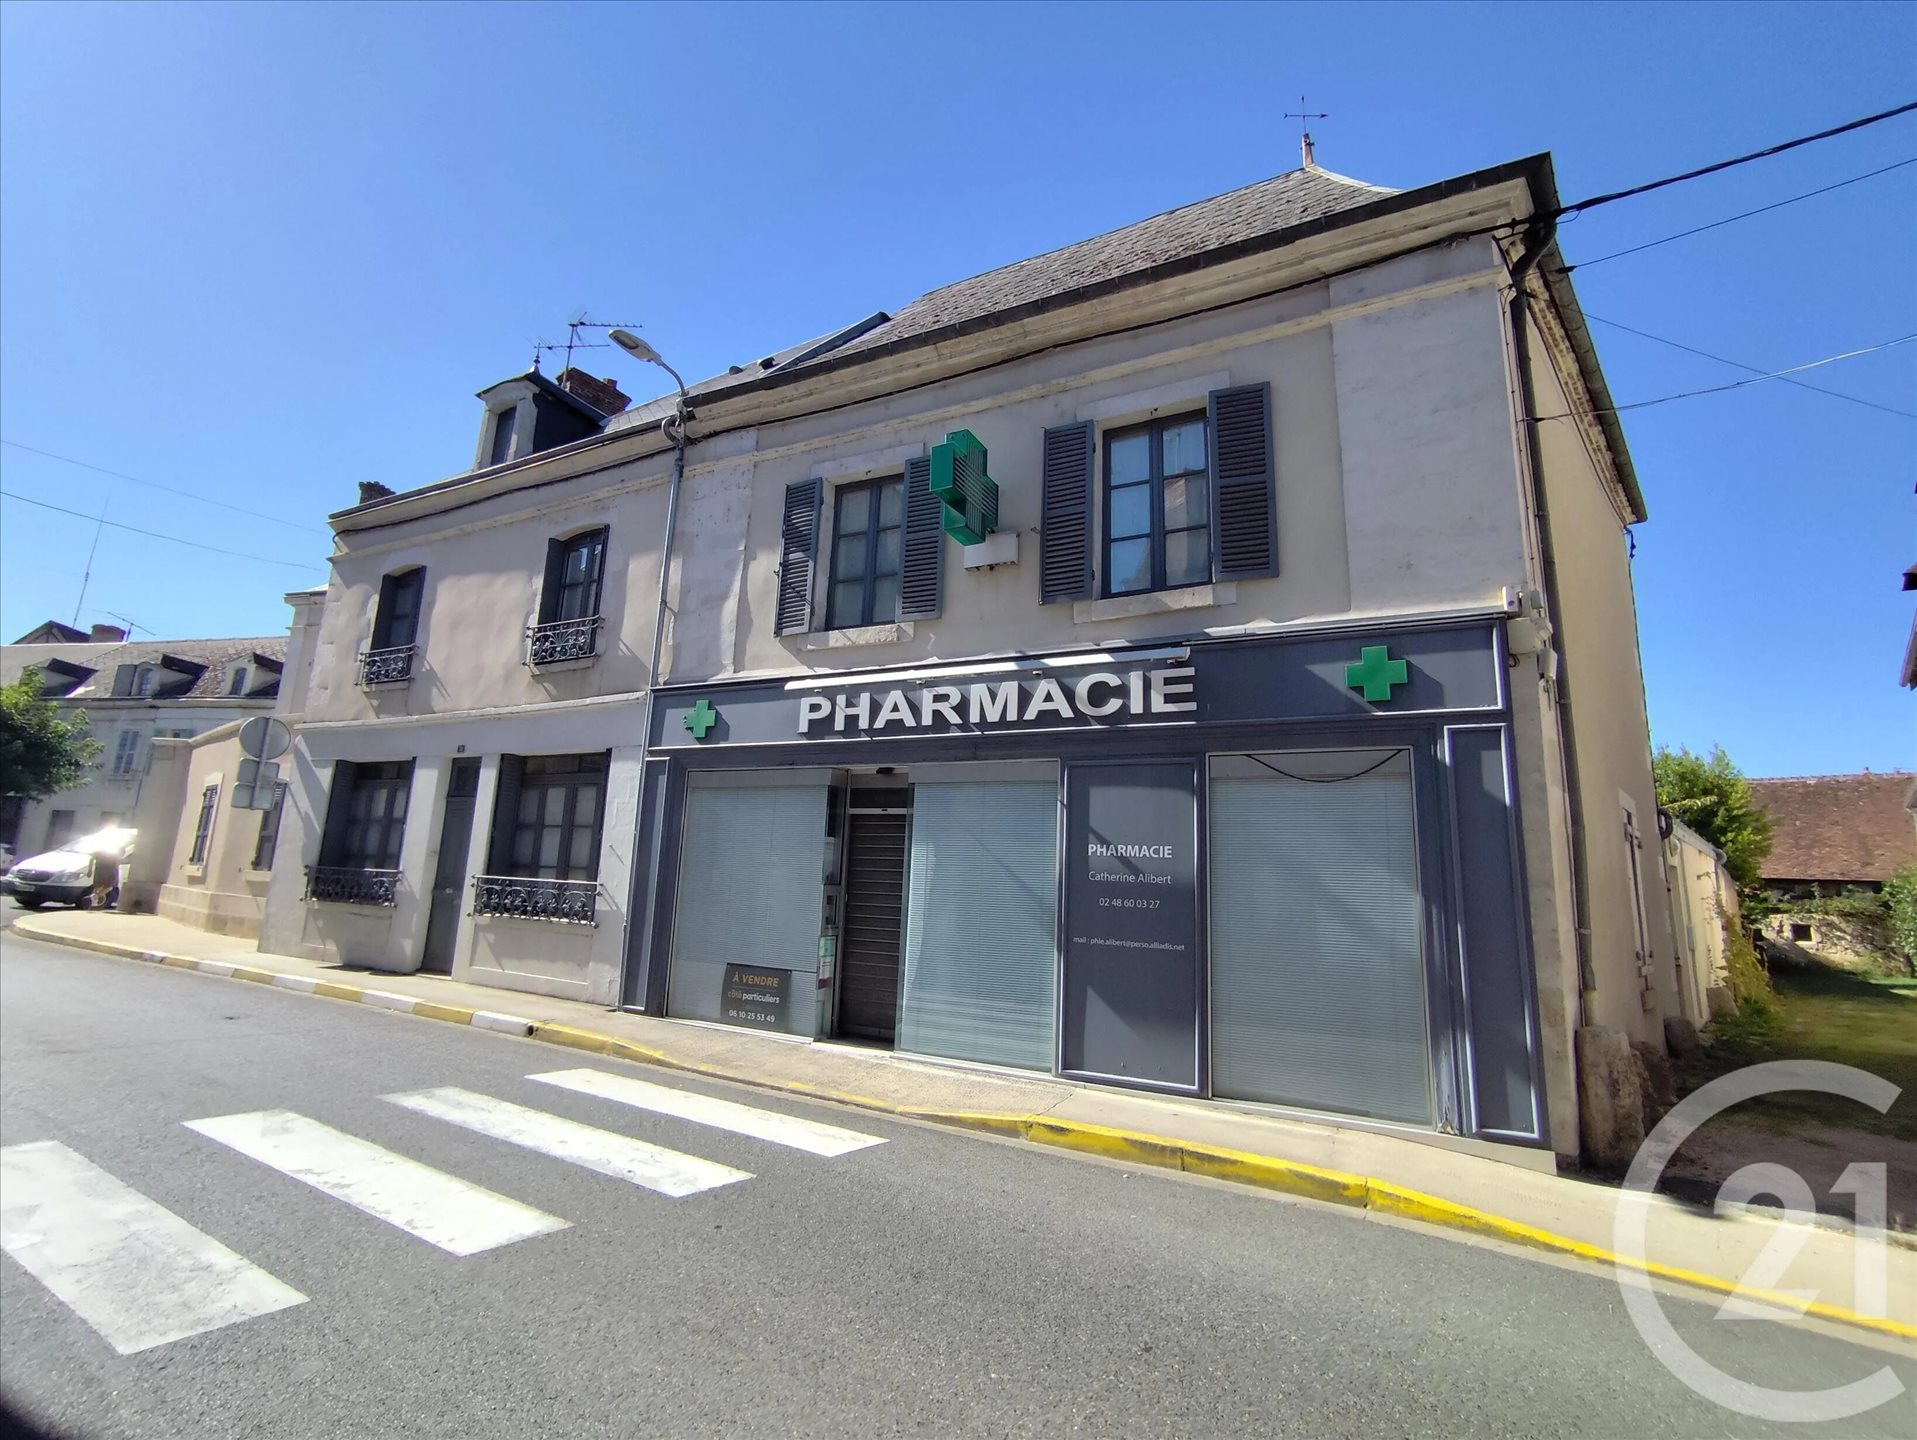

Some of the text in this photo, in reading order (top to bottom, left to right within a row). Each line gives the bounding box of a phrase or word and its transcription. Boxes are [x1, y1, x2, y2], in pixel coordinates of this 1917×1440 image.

[798, 667, 1197, 733] PHARMACIE
[1088, 844, 1172, 858] PHARMACIE
[1088, 871, 1172, 884] Catherine Alibert
[1099, 898, 1160, 909] 02 48 60 03 27
[1073, 936, 1087, 944] mail
[742, 974, 780, 987] VENDRE
[742, 992, 780, 1004] particuliers
[728, 1009, 776, 1023] 06 10 25 53 49
